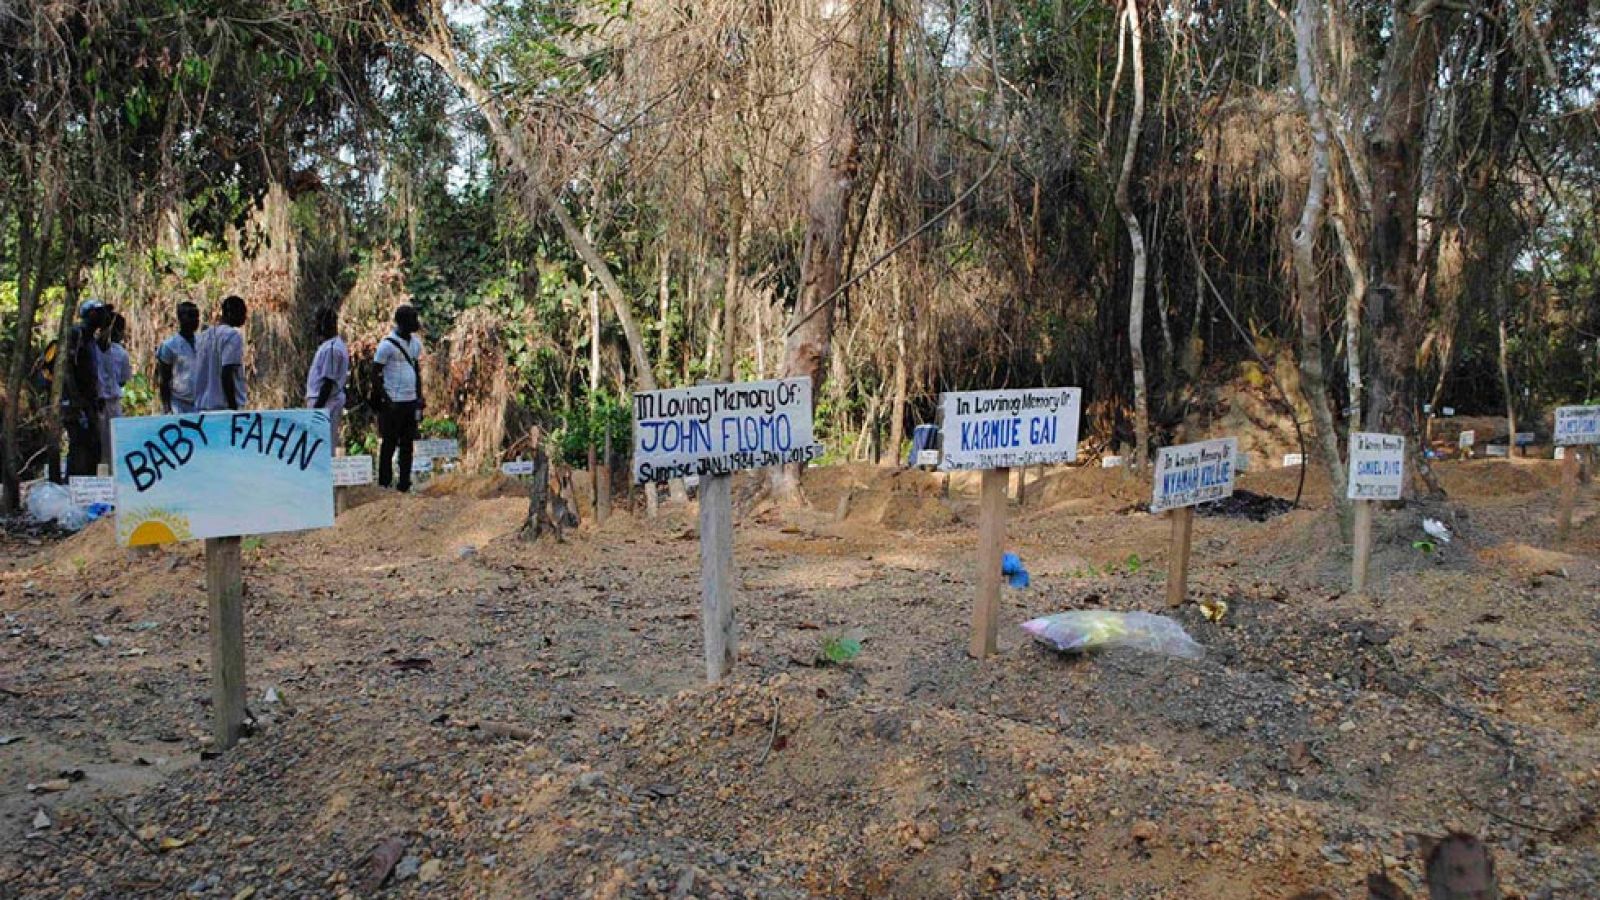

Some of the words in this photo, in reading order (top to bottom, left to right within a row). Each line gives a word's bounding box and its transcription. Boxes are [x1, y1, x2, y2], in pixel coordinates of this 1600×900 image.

[634, 394, 654, 421] In
[658, 391, 712, 423] Loving
[714, 386, 776, 414] Memory
[957, 397, 970, 415] In
[975, 394, 1021, 416] Loving
[1022, 393, 1060, 413] Memory
[639, 420, 711, 453] JOHN
[721, 413, 792, 453] FLOMO
[1029, 415, 1057, 446] GAI
[124, 415, 208, 492] BABY
[230, 412, 324, 471] FAHN
